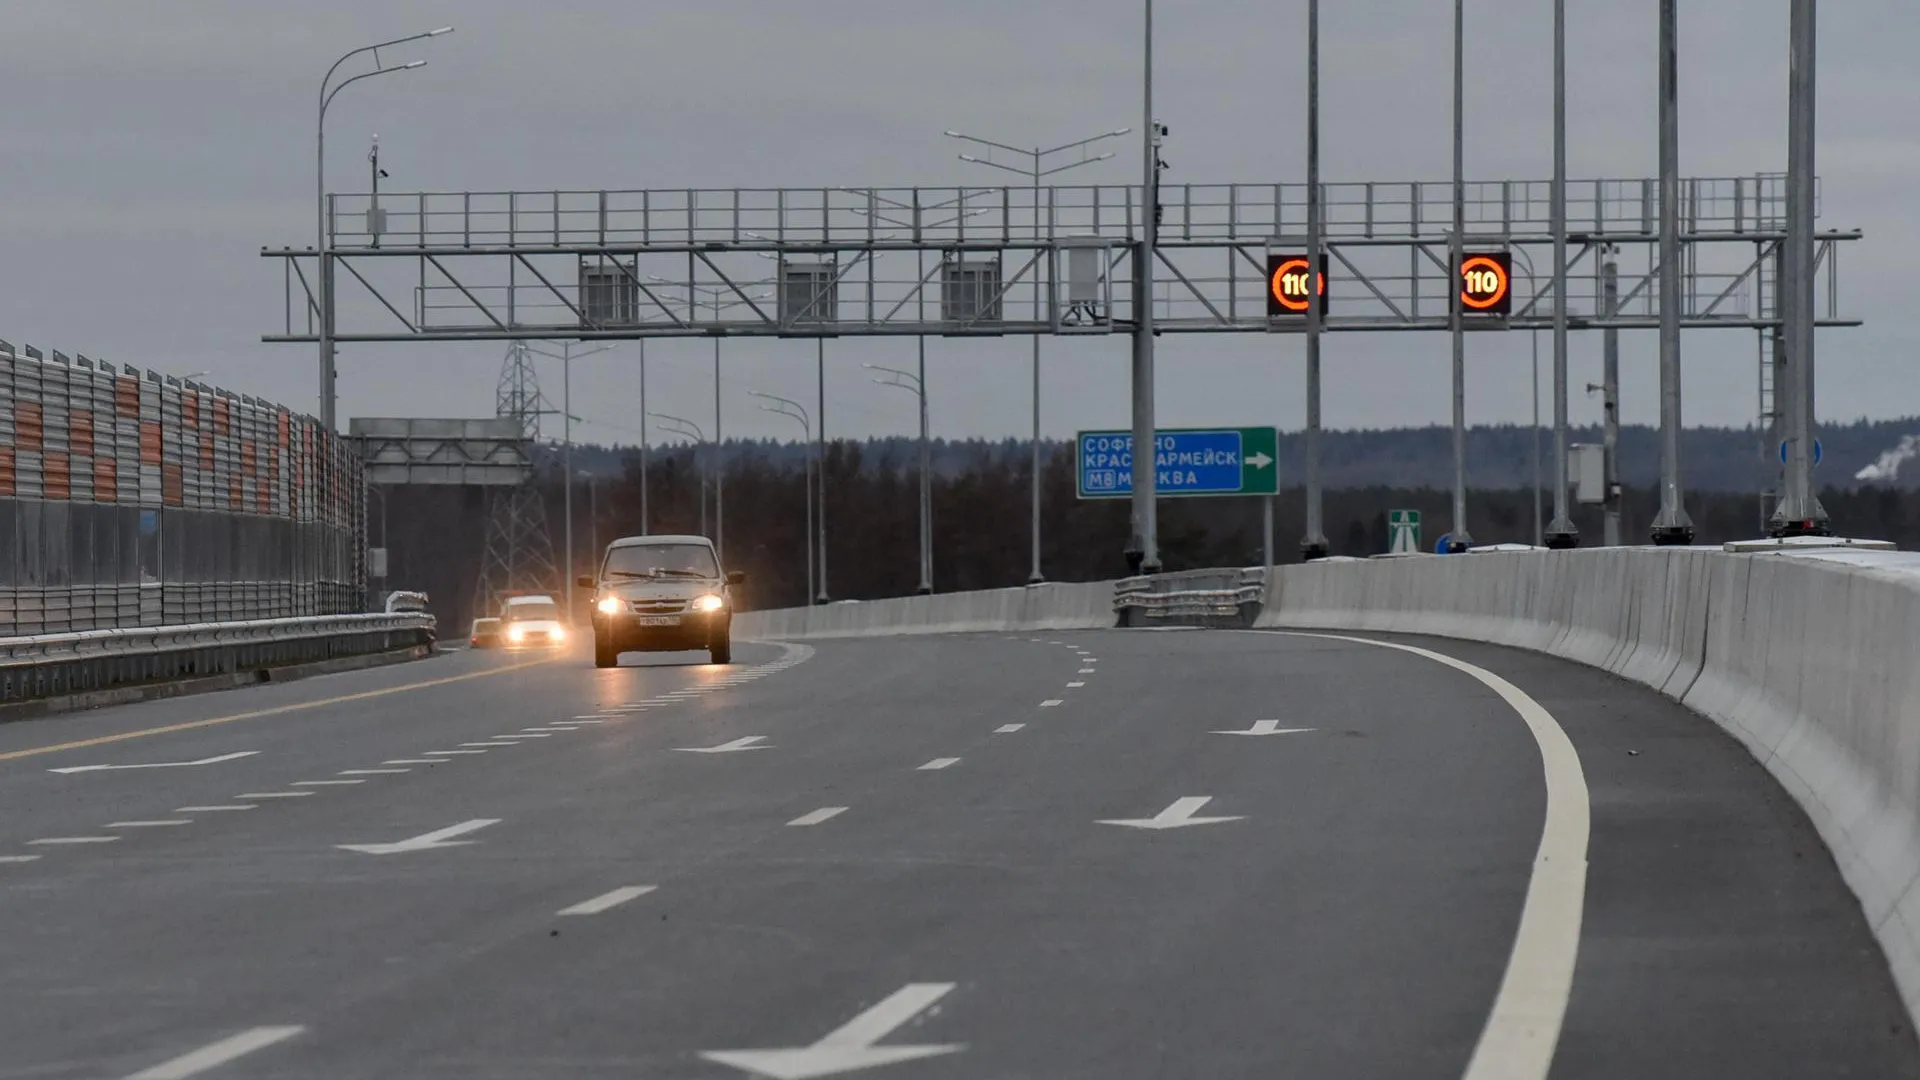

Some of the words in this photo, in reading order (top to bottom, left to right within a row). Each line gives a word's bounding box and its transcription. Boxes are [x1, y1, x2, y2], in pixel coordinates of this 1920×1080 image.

[1464, 271, 1498, 293] 110
[1085, 436, 1175, 452] СОФРНО
[1085, 448, 1237, 467] КРАСАРМЕЙСК
[1090, 472, 1113, 487] М8
[1118, 471, 1197, 485] МКВА
